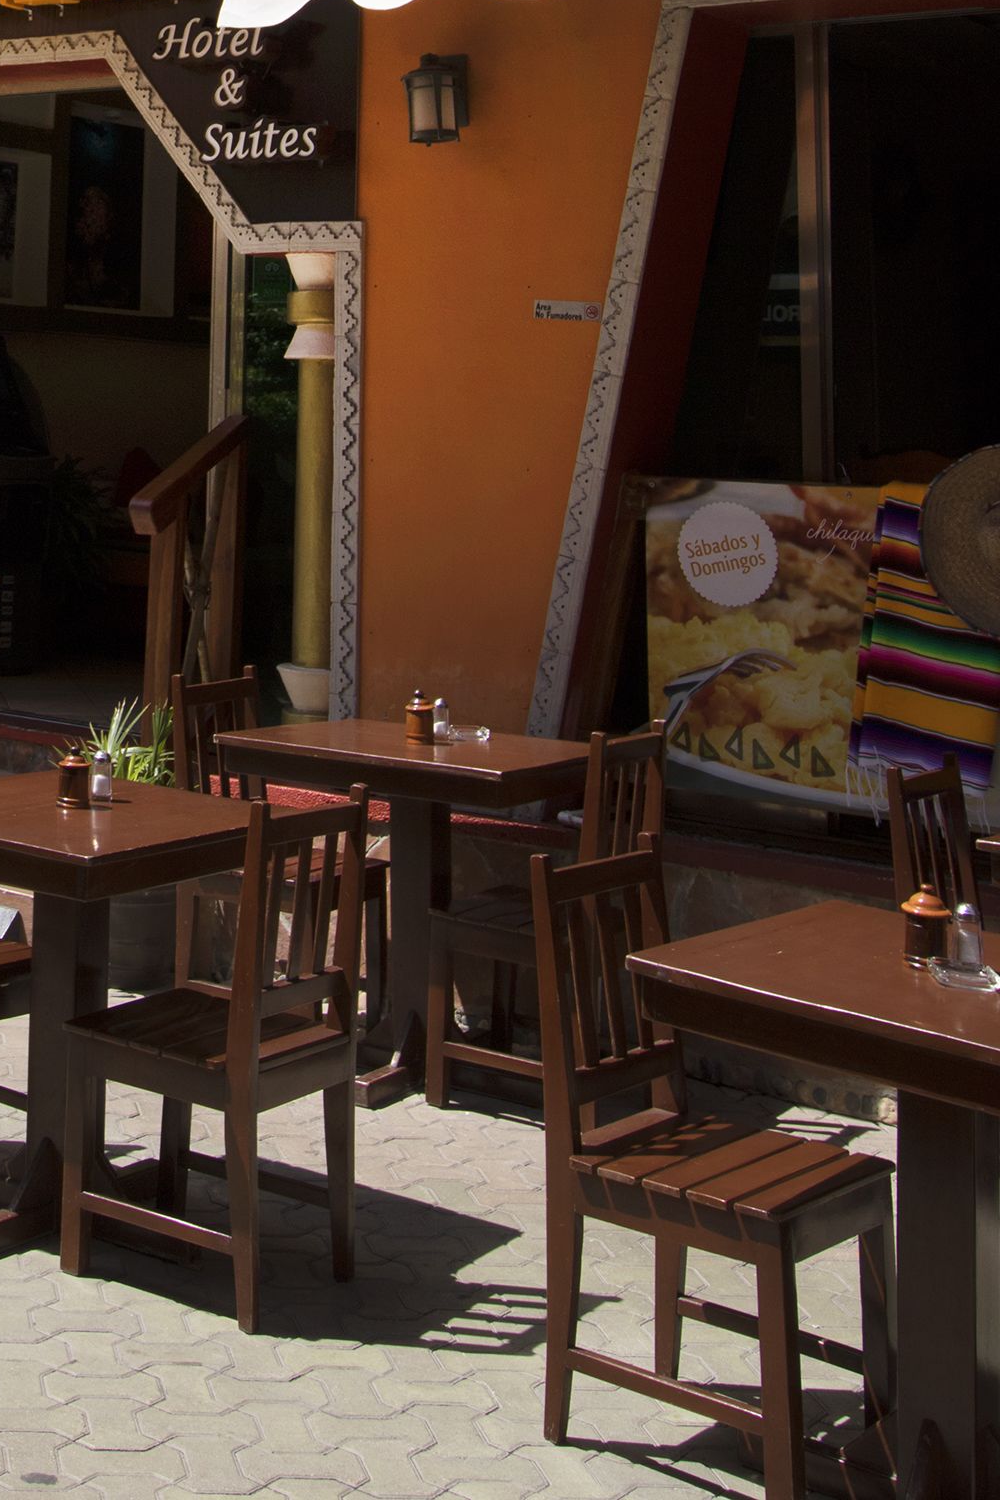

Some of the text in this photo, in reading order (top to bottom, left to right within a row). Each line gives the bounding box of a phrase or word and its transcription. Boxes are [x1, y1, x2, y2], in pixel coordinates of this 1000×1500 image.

[152, 17, 264, 59] Hotel
[214, 68, 246, 107] &
[202, 117, 317, 162] Suites
[684, 533, 761, 559] Sábados y
[690, 552, 767, 578] Domingos
